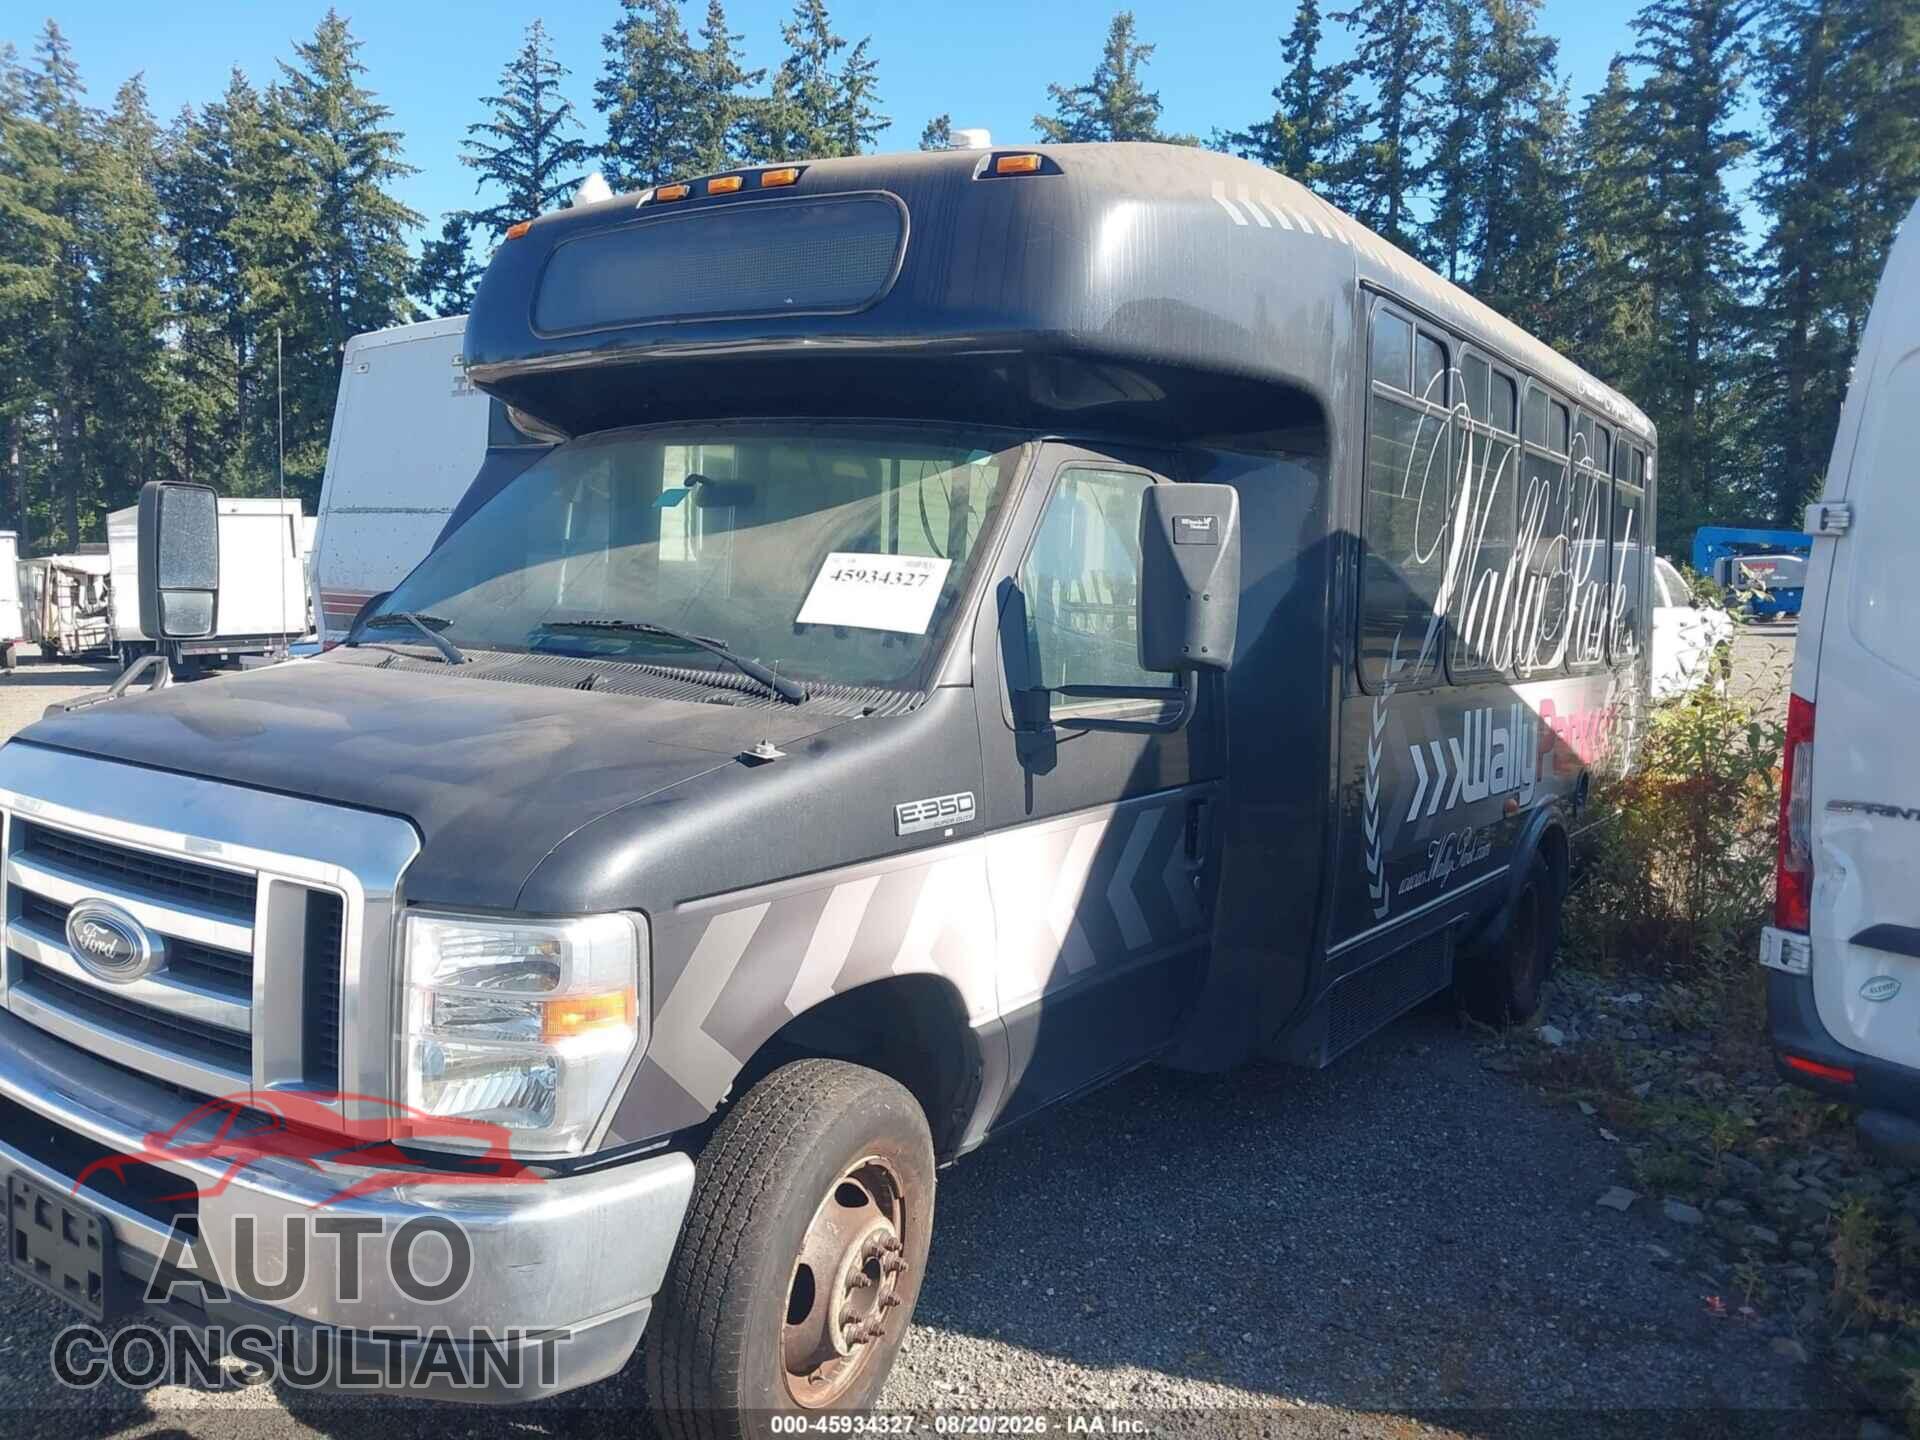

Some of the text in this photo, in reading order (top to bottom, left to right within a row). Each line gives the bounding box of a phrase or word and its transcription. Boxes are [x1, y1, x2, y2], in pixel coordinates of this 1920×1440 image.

[830, 568, 929, 587] 45934327
[899, 794, 973, 824] E-350
[80, 922, 118, 959] Ford
